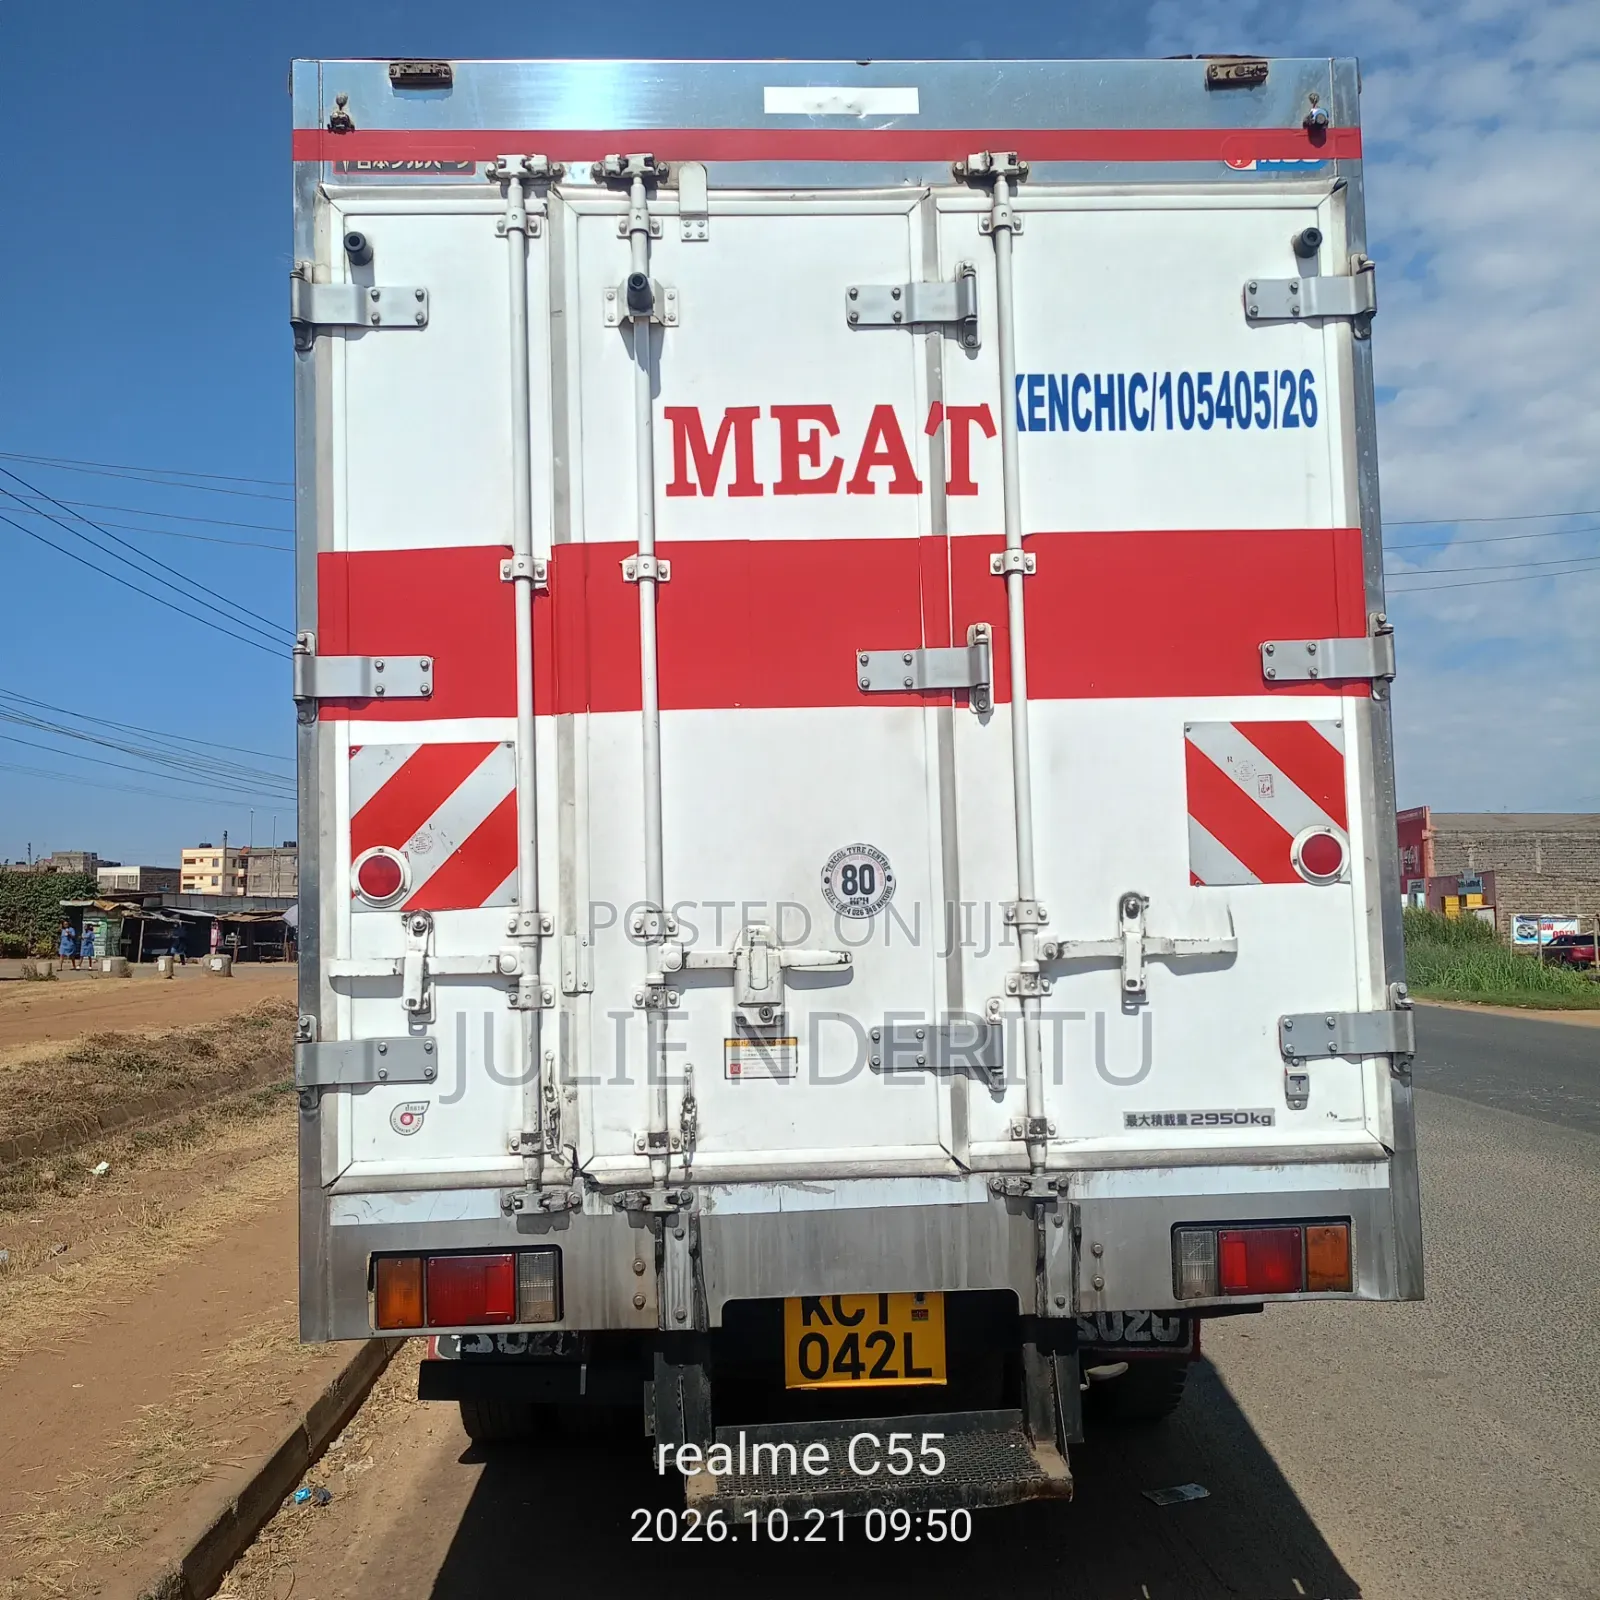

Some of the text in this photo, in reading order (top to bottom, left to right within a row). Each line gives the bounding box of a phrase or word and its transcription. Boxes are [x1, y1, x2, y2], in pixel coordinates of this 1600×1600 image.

[1015, 369, 1318, 432] KENCHIC/105405/26
[664, 400, 997, 497] MEAT
[847, 846, 867, 855] TYRE
[867, 848, 891, 871] CENTRE
[841, 863, 876, 896] 80
[1190, 1112, 1271, 1126] 2950kg
[798, 1330, 933, 1380] 042L
